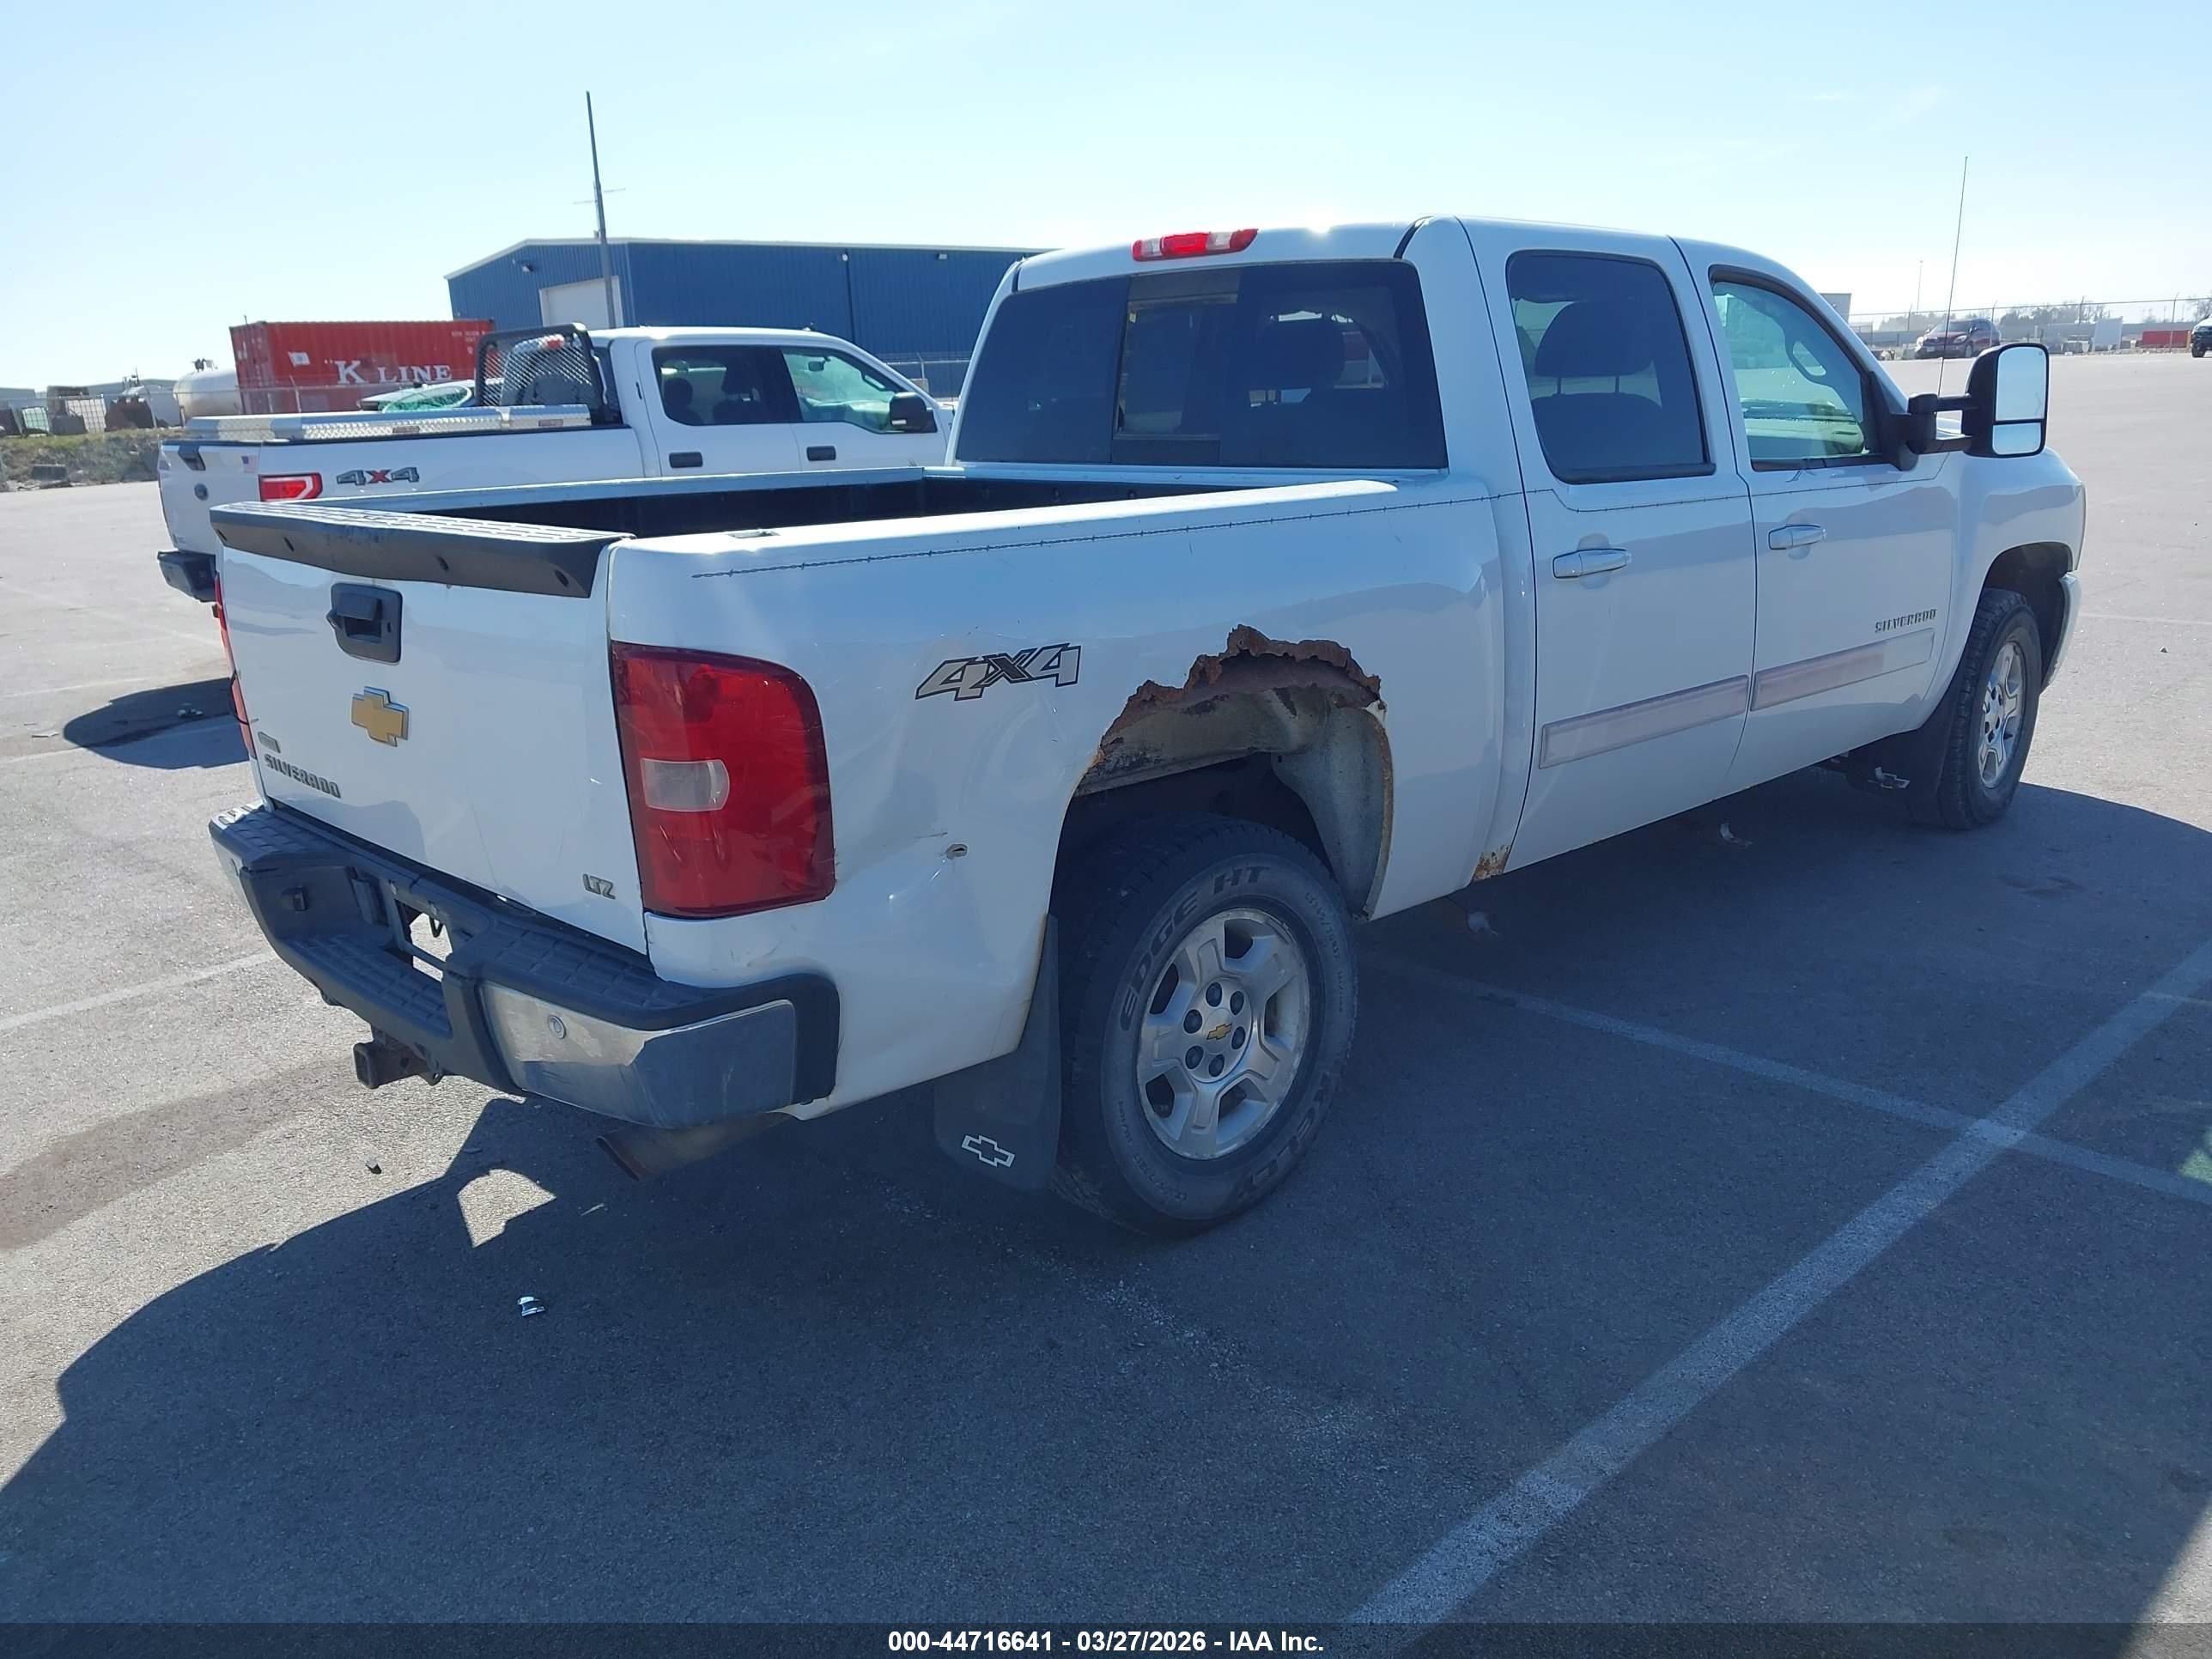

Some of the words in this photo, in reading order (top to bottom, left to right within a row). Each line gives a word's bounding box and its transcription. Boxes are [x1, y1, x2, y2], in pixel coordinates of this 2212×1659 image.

[378, 365, 452, 384] LINE
[1875, 608, 1938, 634] SILVERADO
[264, 752, 342, 799] SILVERADO
[582, 872, 617, 900] LTZ
[1120, 890, 1198, 1031] EDGE
[1212, 866, 1271, 895] HT
